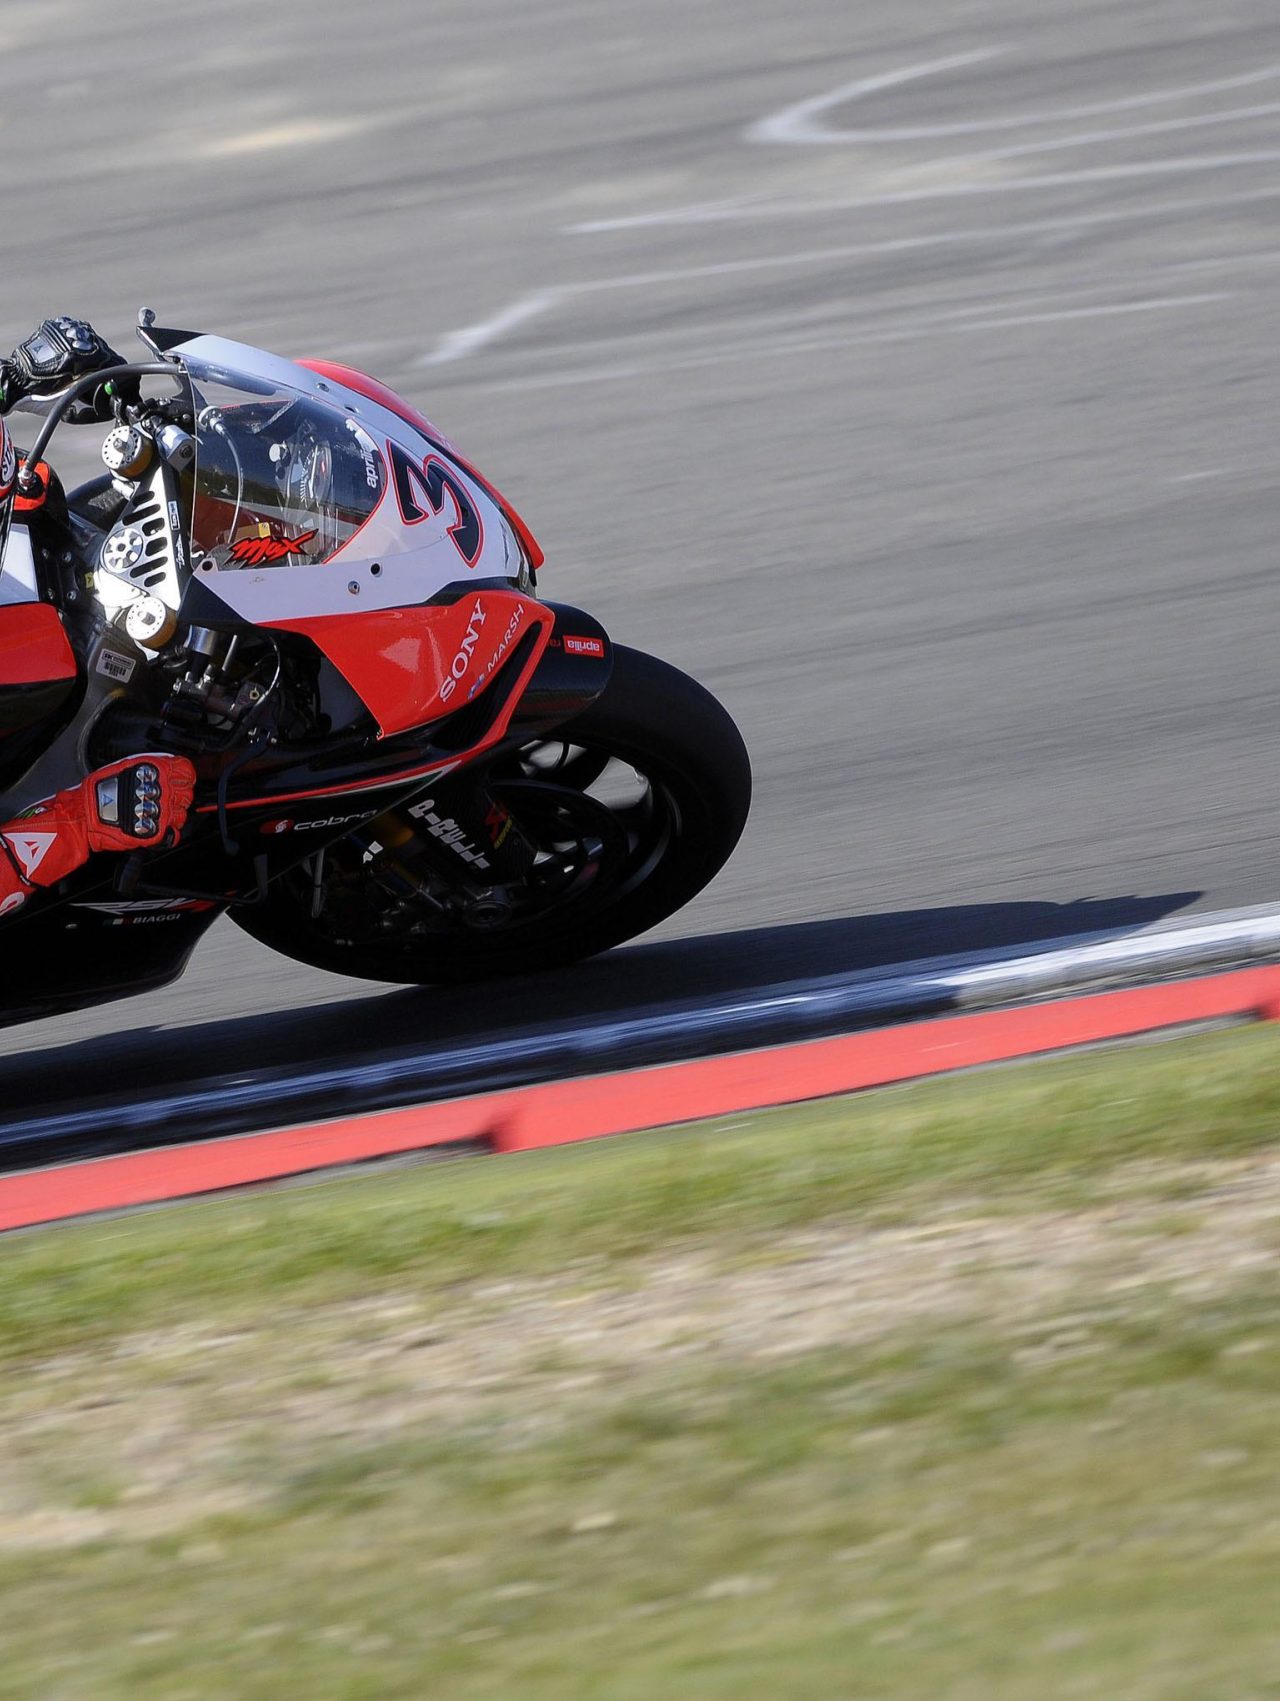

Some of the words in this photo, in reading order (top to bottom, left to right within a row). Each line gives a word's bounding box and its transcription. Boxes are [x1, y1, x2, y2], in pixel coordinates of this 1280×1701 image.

[386, 438, 484, 568] 3
[439, 598, 487, 703] SONY
[487, 603, 525, 672] MARSH
[566, 639, 601, 653] aprilia
[407, 799, 491, 870] PIRELLI
[132, 913, 182, 925] BIAGGI
